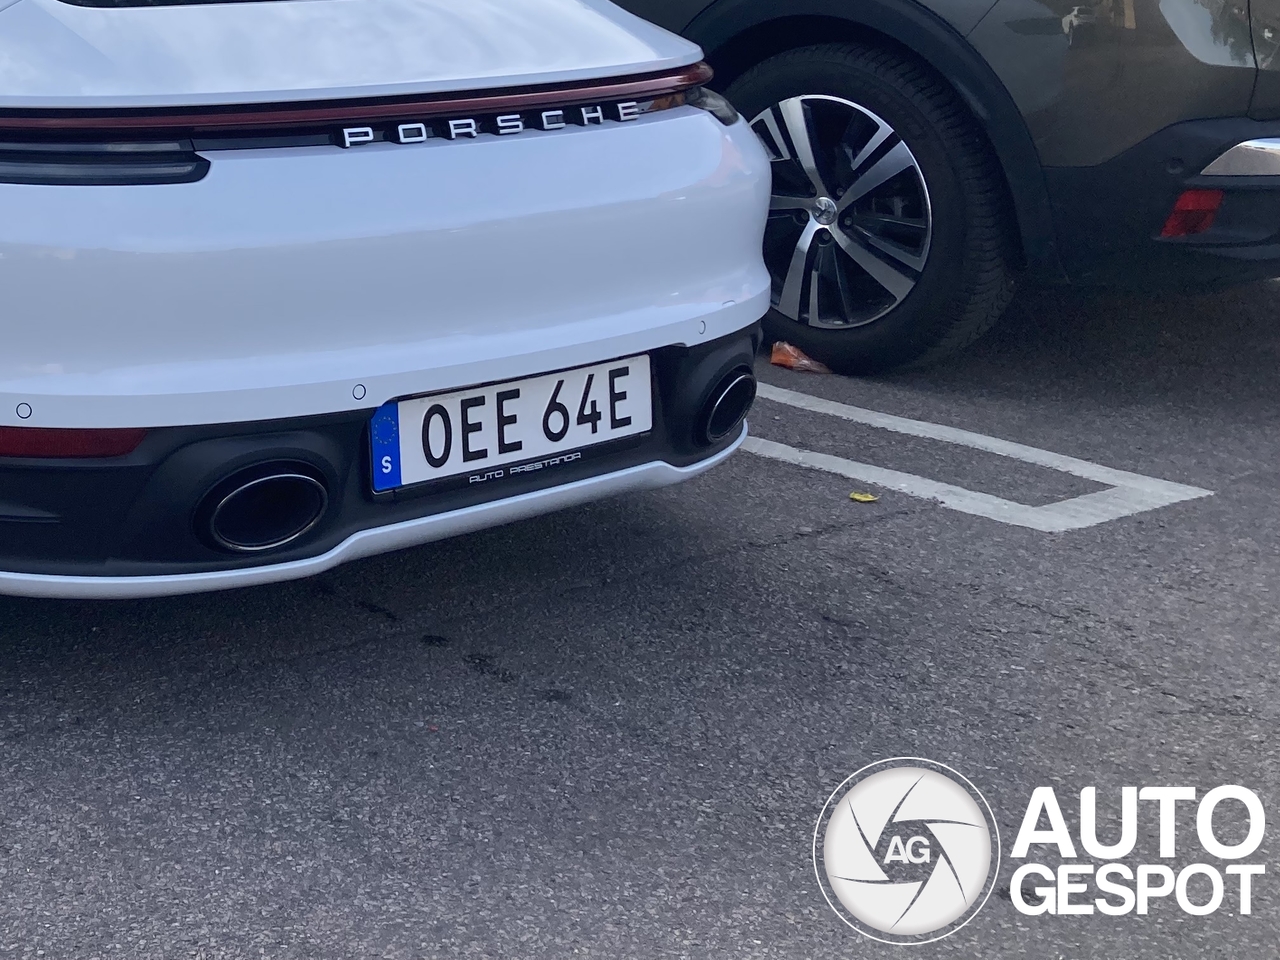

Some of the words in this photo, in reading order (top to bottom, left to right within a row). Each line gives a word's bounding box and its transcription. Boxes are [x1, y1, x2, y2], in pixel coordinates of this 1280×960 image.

[343, 101, 640, 148] PORSCHE
[421, 388, 523, 468] OEE
[542, 366, 632, 442] 64E
[381, 455, 392, 474] S
[469, 469, 504, 484] AUTO
[509, 452, 581, 475] PRESTANDA
